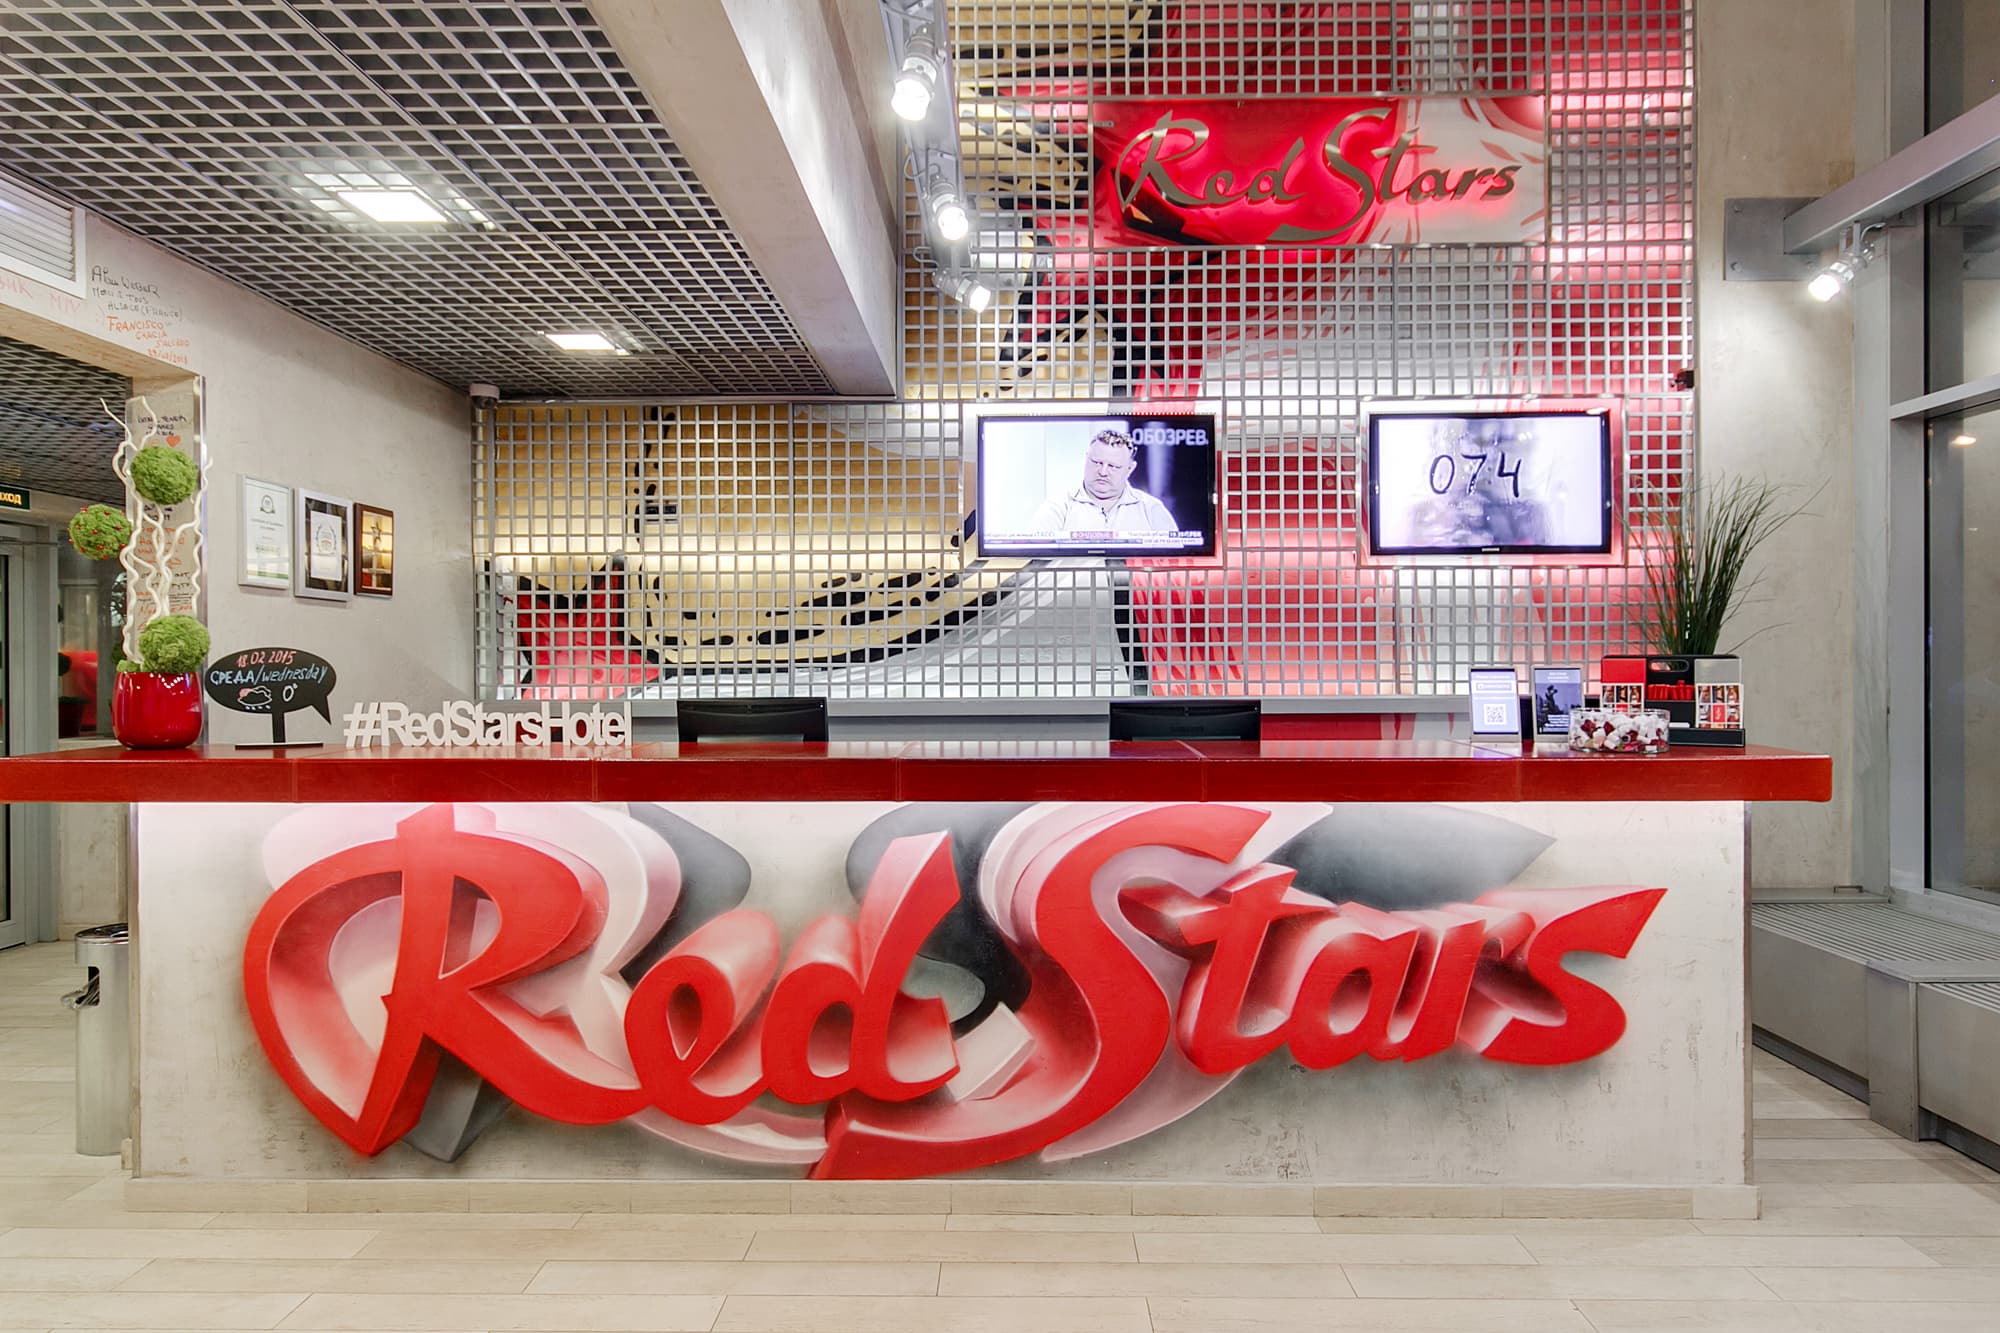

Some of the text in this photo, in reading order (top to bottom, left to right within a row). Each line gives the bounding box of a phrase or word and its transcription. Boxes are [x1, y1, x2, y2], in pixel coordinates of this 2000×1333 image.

[1114, 107, 1523, 242] Red Stars
[1429, 451, 1522, 498] 074
[268, 650, 297, 665] 2015
[343, 701, 632, 747] #RedStarsHotel
[243, 802, 1668, 1179] Red Stars
